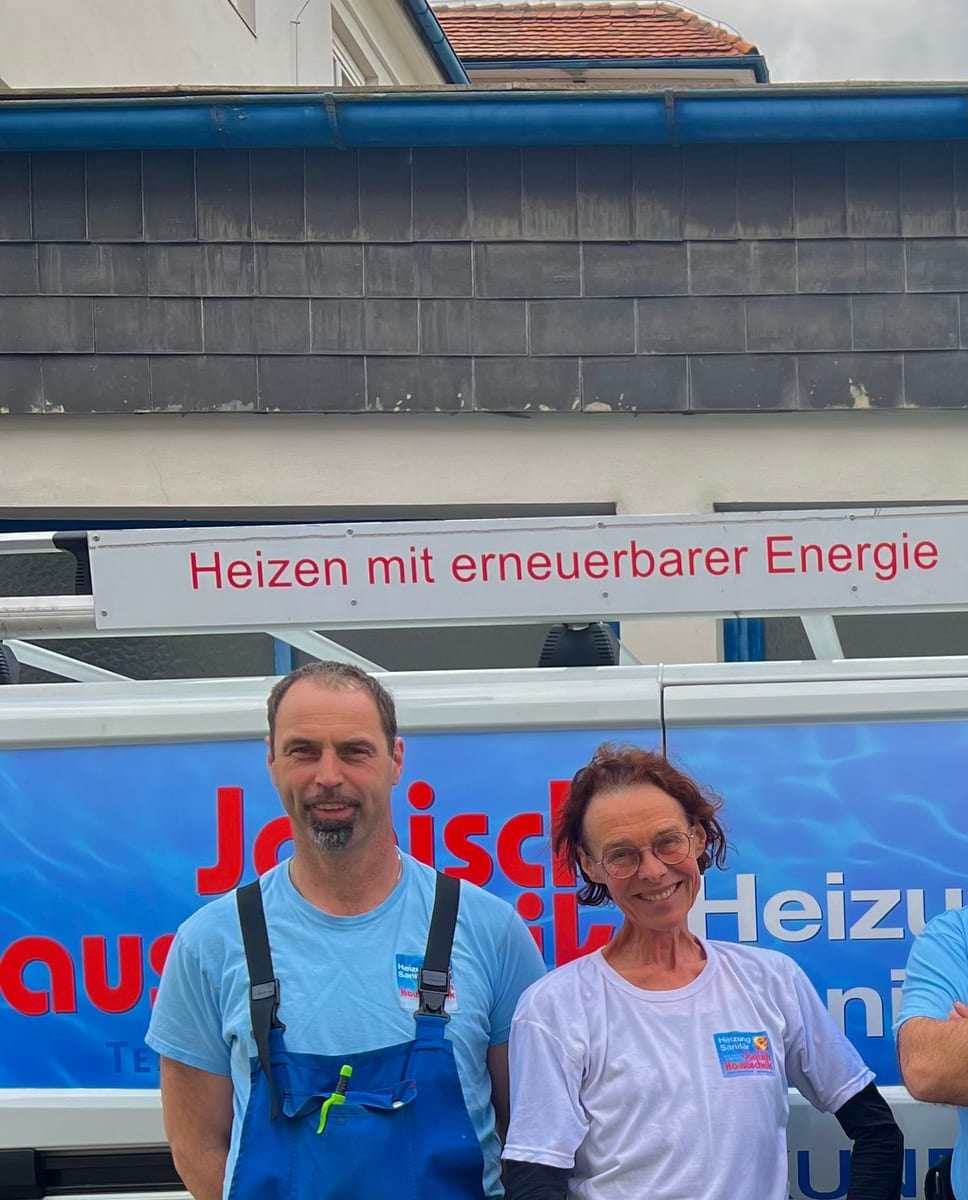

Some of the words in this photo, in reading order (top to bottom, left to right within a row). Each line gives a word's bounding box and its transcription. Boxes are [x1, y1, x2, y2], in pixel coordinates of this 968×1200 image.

[190, 550, 348, 590] Heizen
[368, 546, 435, 584] mit
[451, 540, 748, 583] erneuerbarer
[766, 532, 939, 581] Energie
